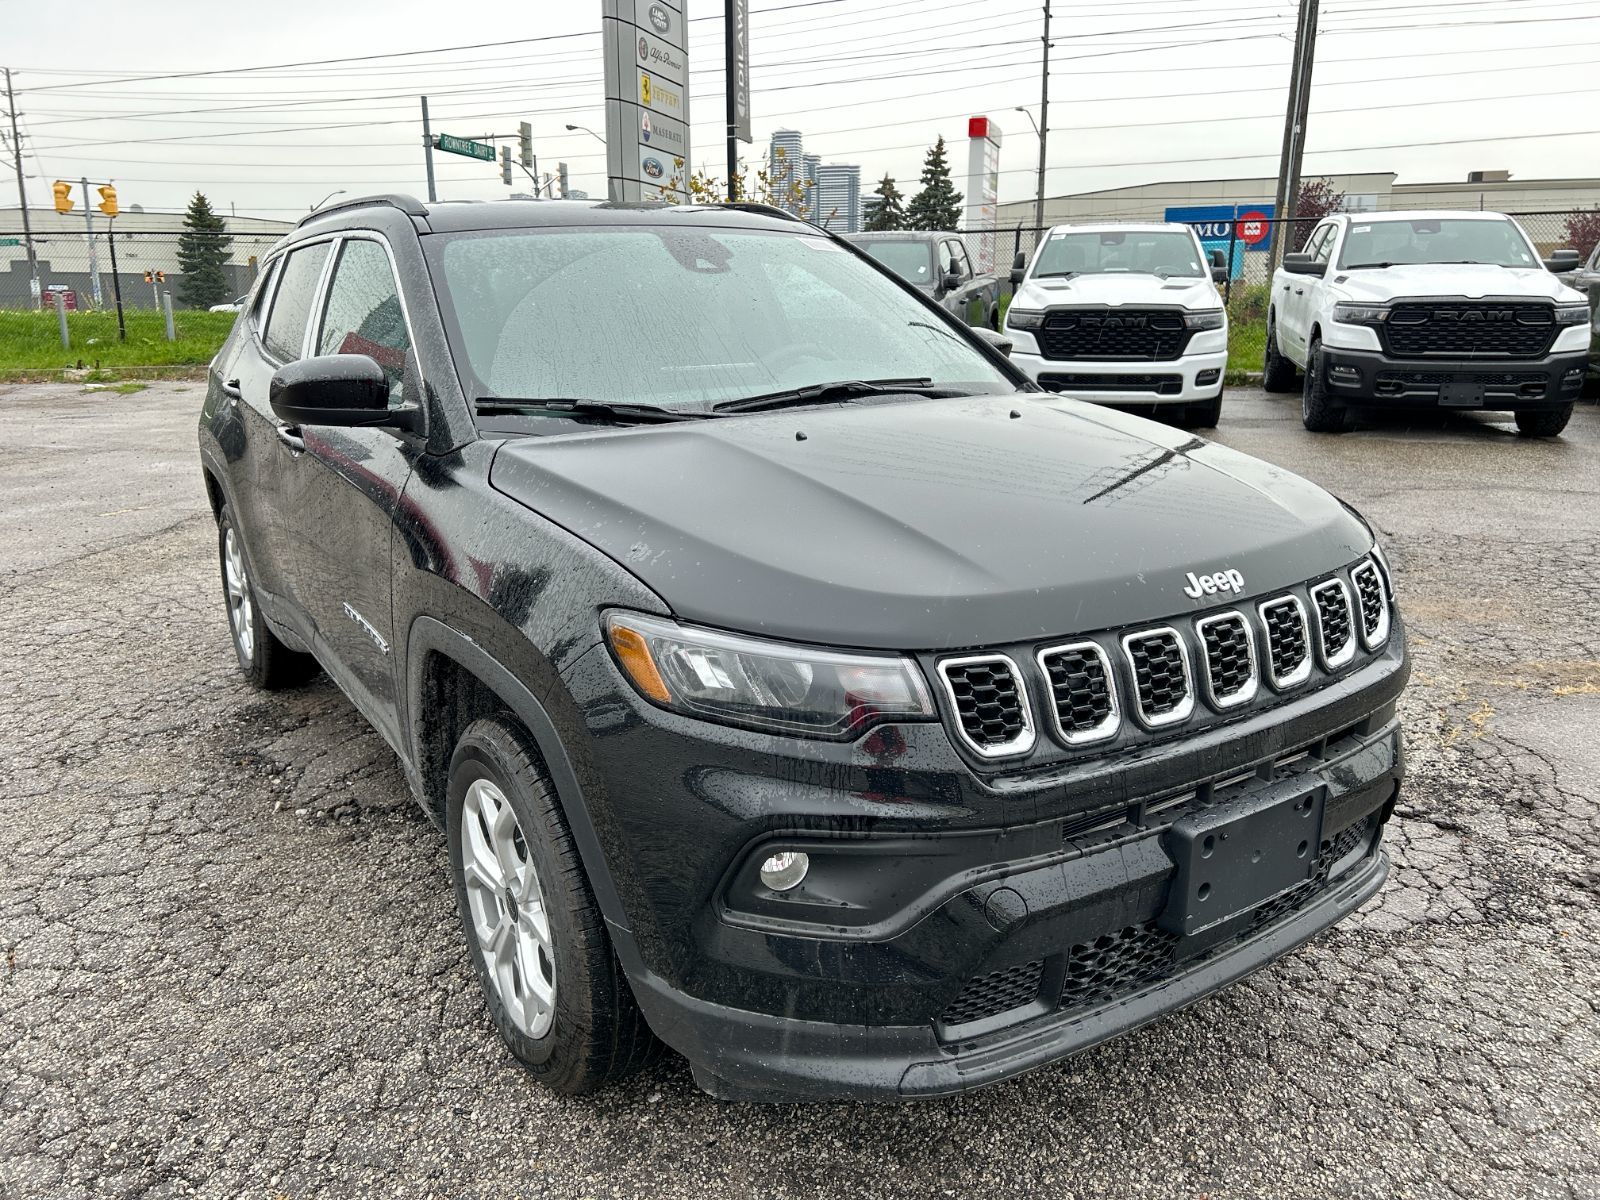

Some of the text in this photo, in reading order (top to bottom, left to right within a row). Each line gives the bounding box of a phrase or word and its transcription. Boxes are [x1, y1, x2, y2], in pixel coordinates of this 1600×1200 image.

[652, 7, 665, 20] LAND
[650, 47, 663, 63] Alfa
[652, 124, 682, 143] MASERATI
[444, 136, 472, 154] ROWNTREE
[473, 143, 488, 158] DAIRY
[645, 161, 660, 176] Ford
[1189, 222, 1230, 237] MO
[1080, 317, 1147, 327] RAM
[1433, 310, 1513, 320] RAM
[1183, 568, 1245, 599] Jeep
